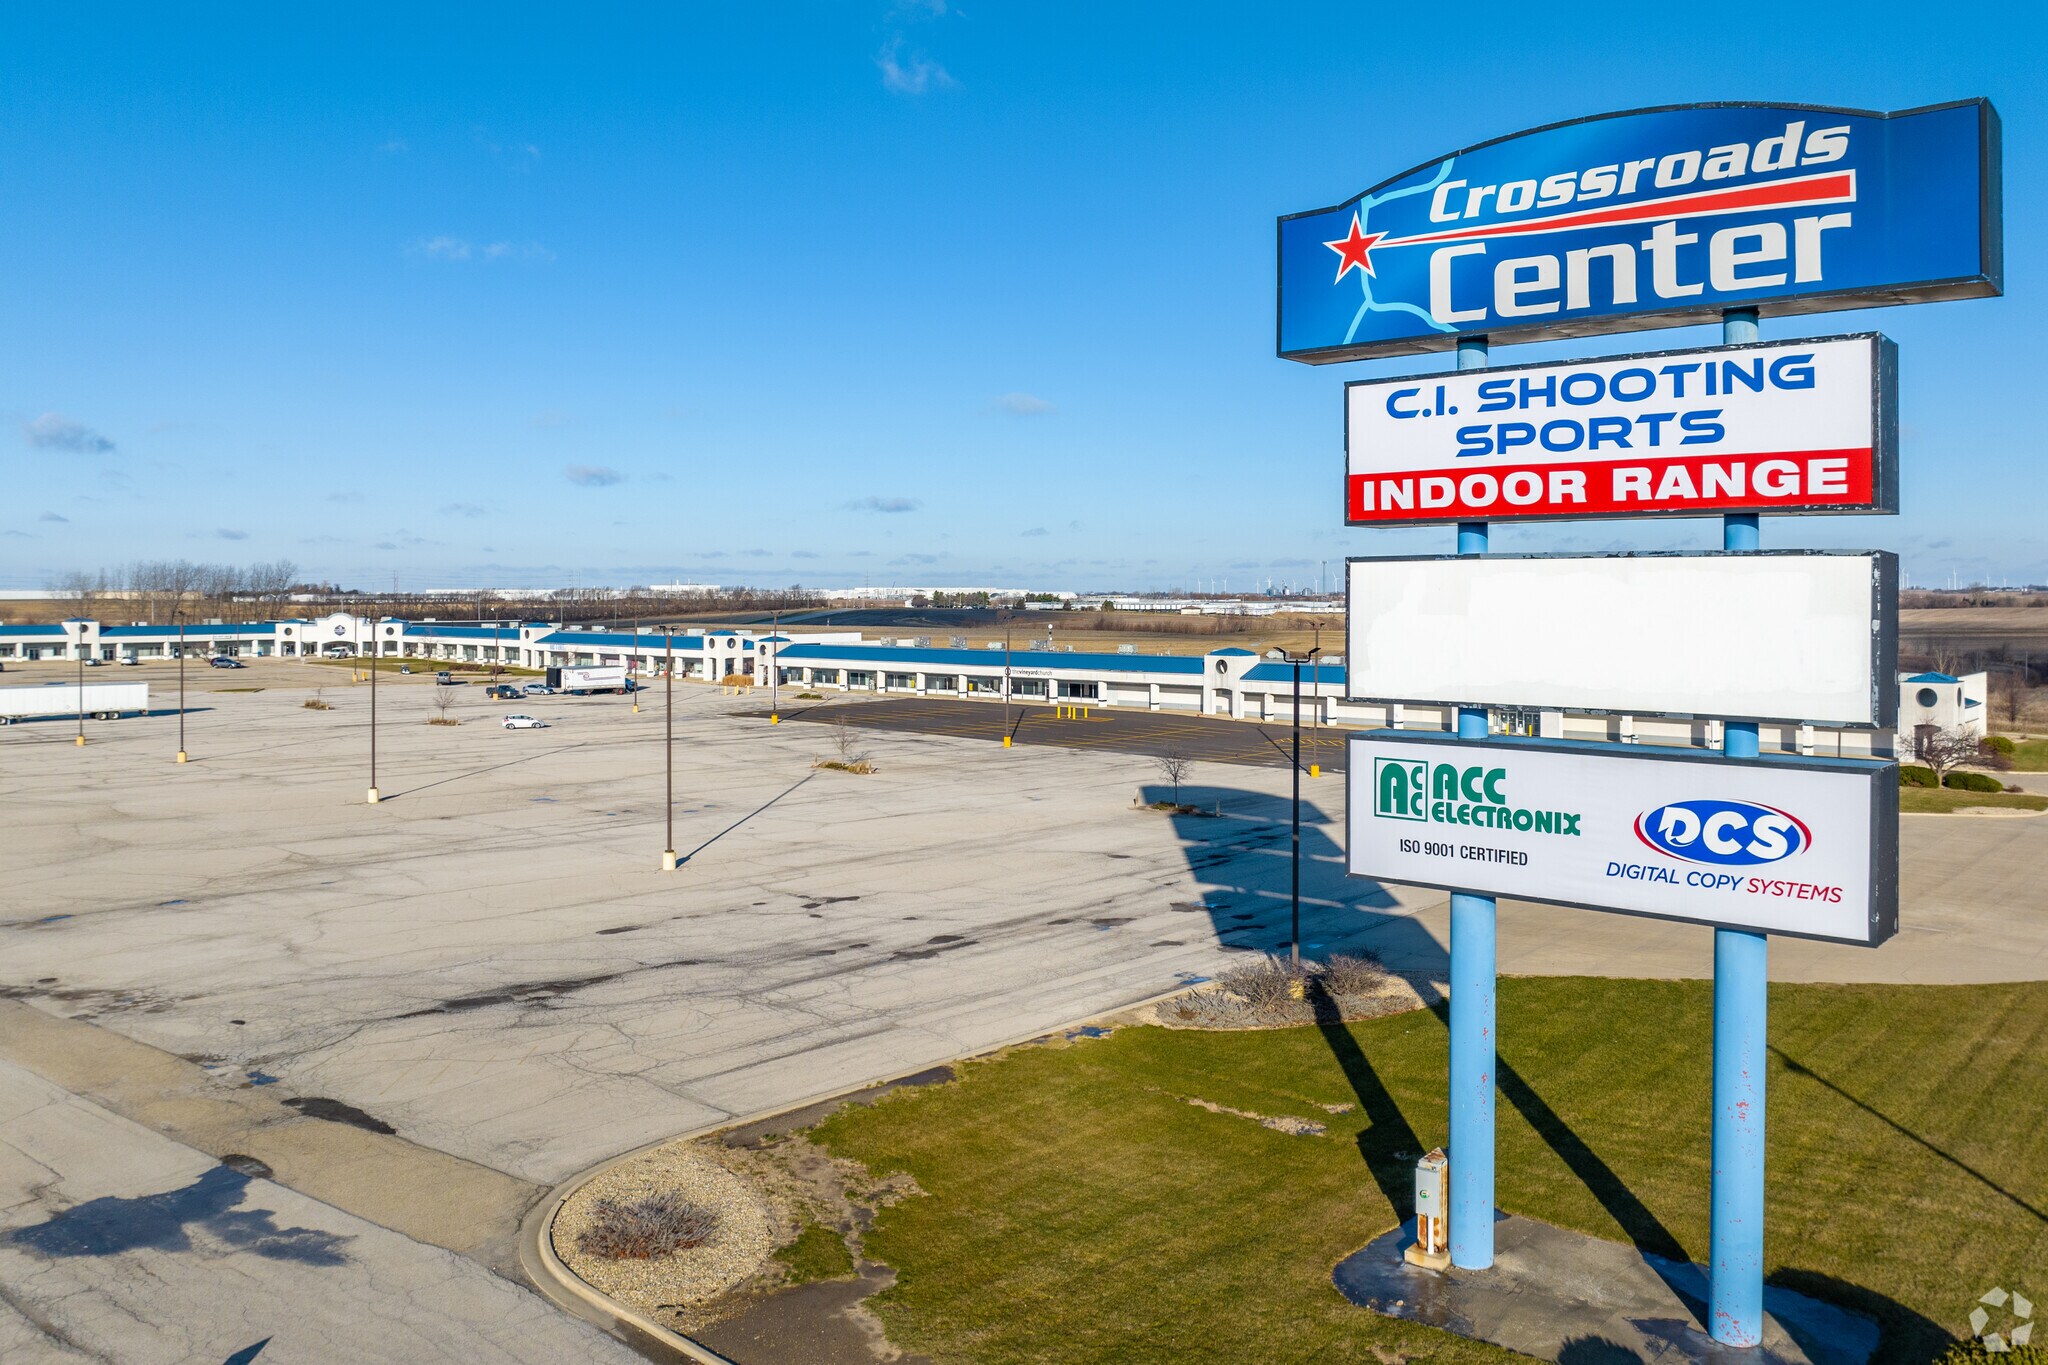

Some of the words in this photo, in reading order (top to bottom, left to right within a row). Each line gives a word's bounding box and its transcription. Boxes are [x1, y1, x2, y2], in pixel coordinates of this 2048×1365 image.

[1429, 121, 1851, 224] Crossroads
[1429, 212, 1852, 323] Center
[1386, 387, 1458, 419] C.I.
[1476, 353, 1816, 412] SHOOTING
[1456, 408, 1726, 458] SPORTS
[1363, 470, 1587, 511] INDOOR
[1612, 458, 1849, 505] RANGE
[1433, 763, 1506, 805] ACC
[1431, 801, 1581, 837] ELECTRONIX
[1657, 806, 1794, 860] DCS
[1400, 838, 1421, 854] ISO
[1424, 842, 1455, 858] 9001
[1460, 845, 1528, 867] CERTIFIED
[1606, 861, 1680, 885] DIGITAL
[1686, 871, 1745, 892] COPY
[1746, 877, 1843, 904] SYSTEMS
